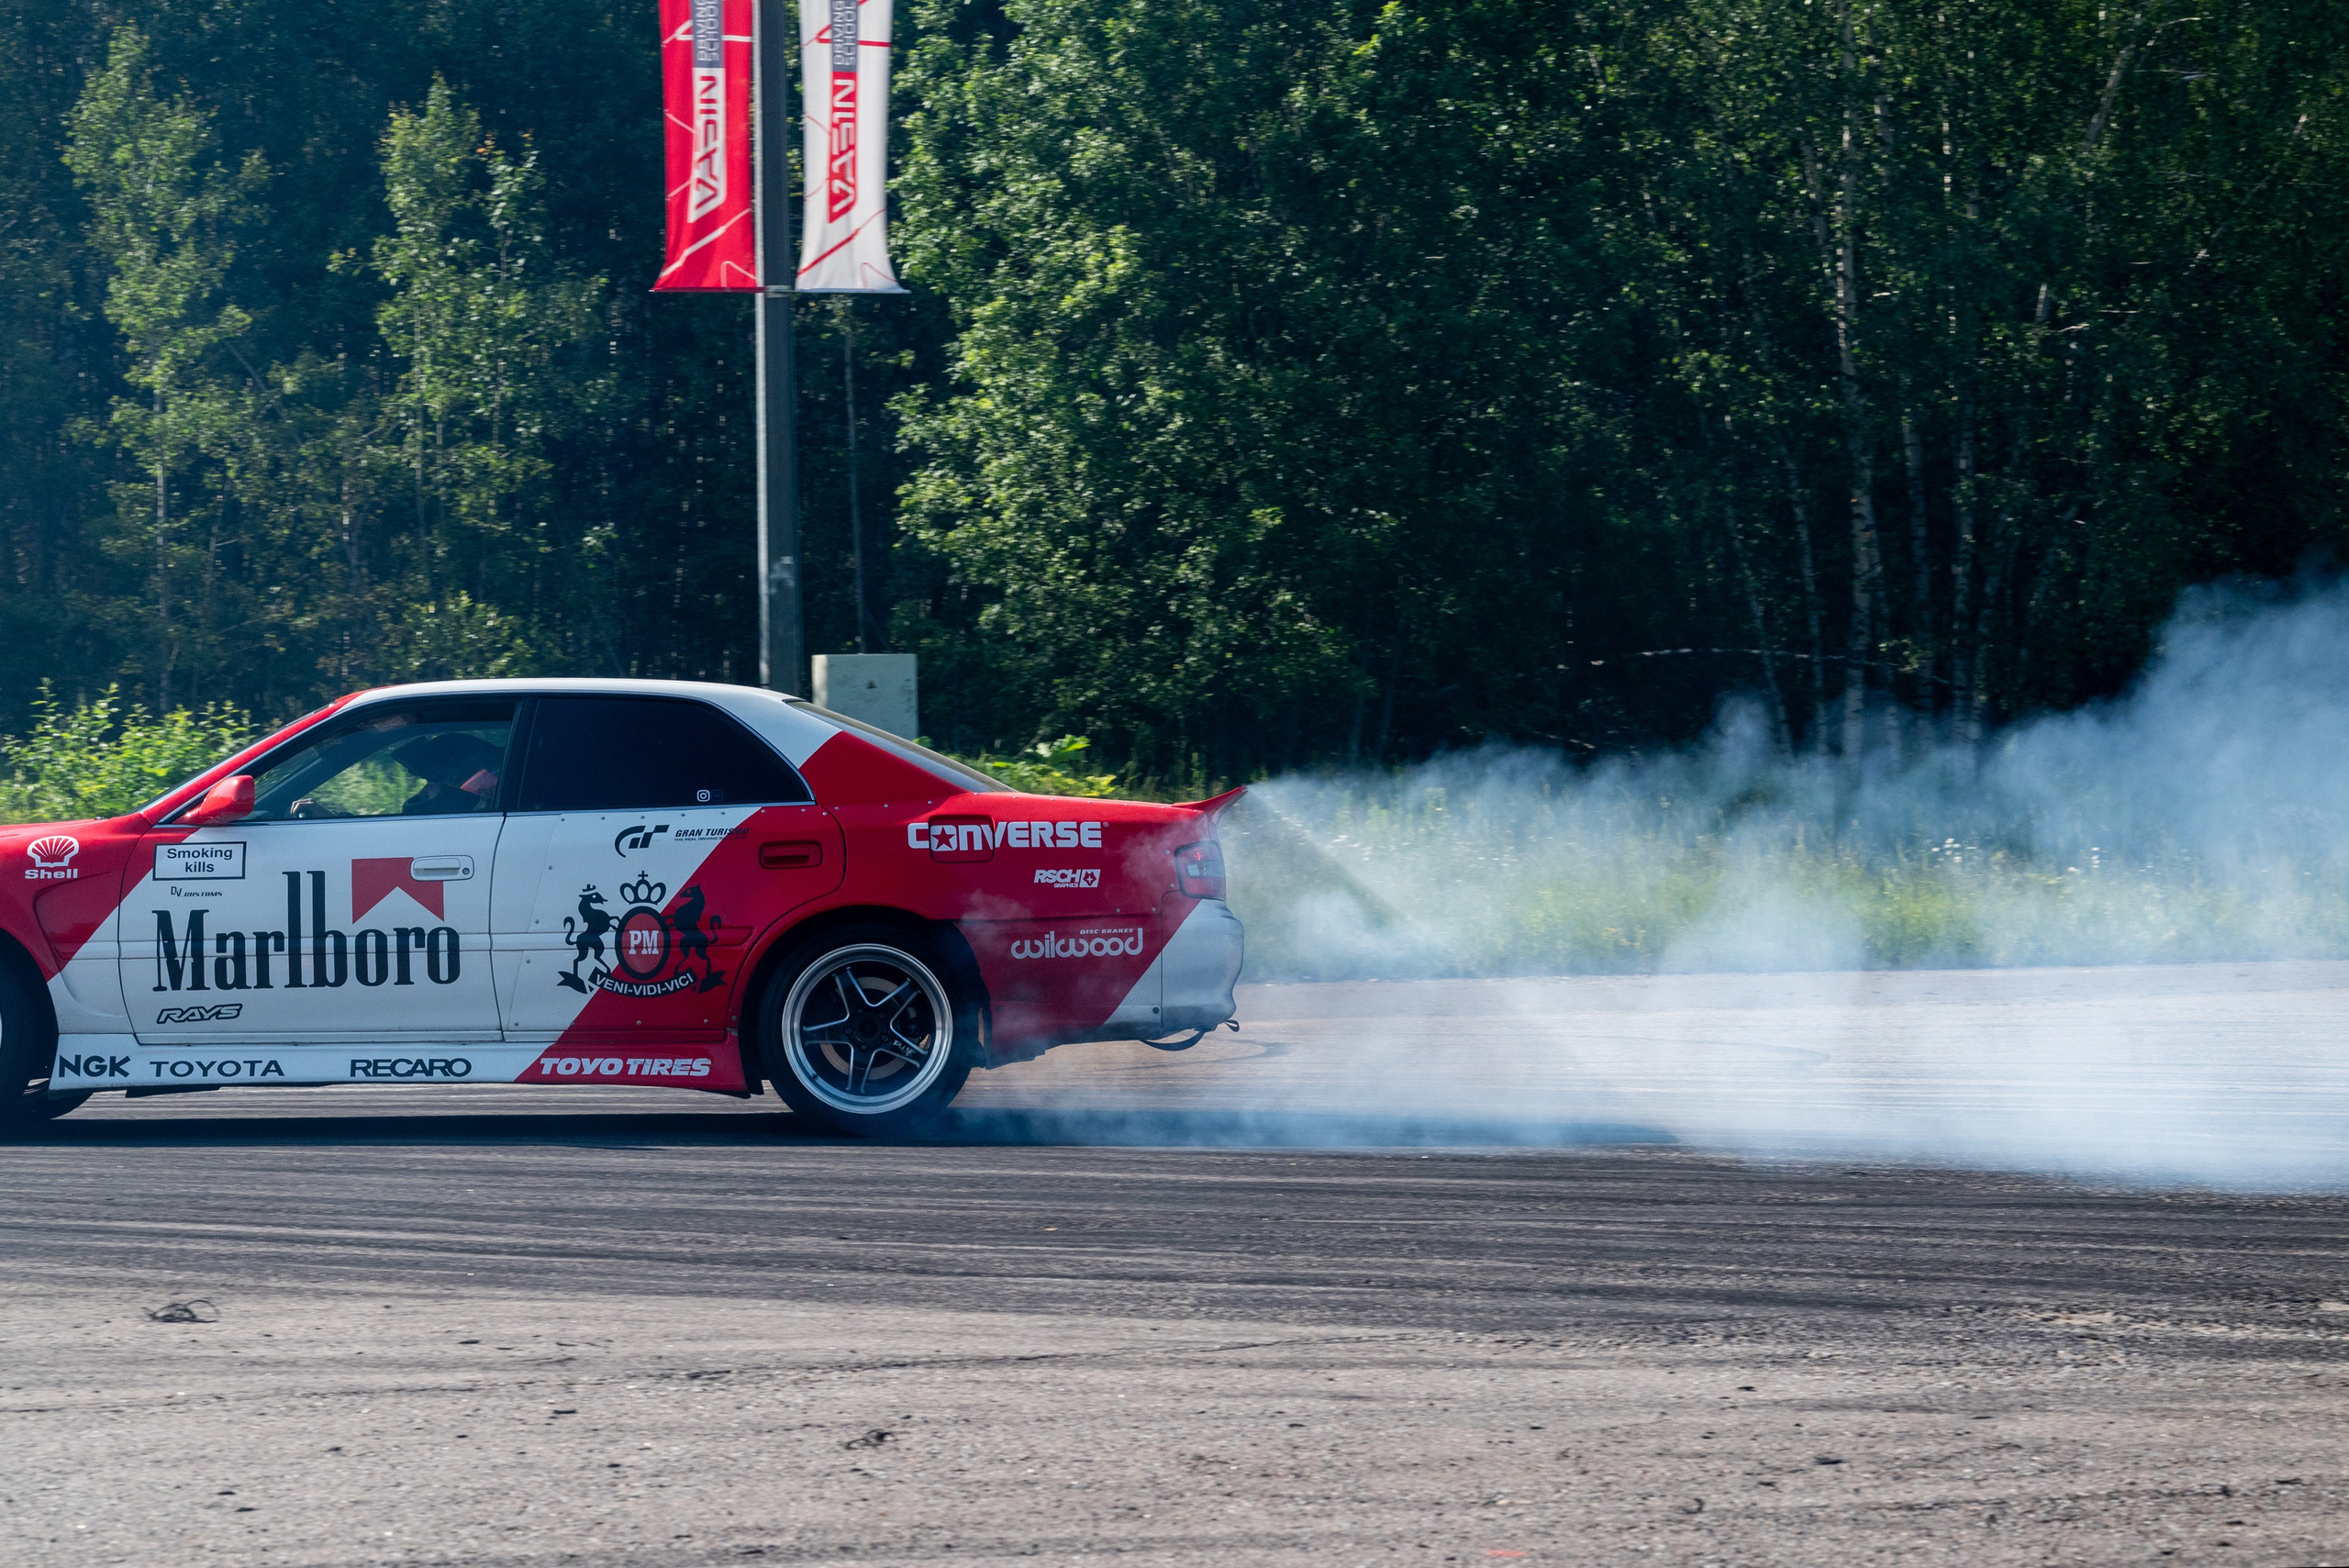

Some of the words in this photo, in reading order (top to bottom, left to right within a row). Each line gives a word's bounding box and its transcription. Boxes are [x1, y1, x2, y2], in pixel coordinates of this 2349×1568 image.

[832, 0, 844, 64] DRIVING
[842, 1, 856, 65] SCHOOL
[675, 828, 703, 837] GRAN
[706, 828, 750, 836] TURISMO
[167, 847, 233, 861] Smoking
[25, 869, 78, 879] Shell
[184, 862, 215, 873] kills
[1033, 869, 1081, 883] RSCH
[152, 871, 461, 992] Marlboro
[629, 929, 659, 955] PM
[1010, 927, 1143, 960] wilwood
[596, 973, 694, 996] VENI-VIDI-VICI
[156, 1003, 243, 1025] RAYS
[59, 1054, 131, 1078] NGK
[150, 1060, 284, 1077] TOYOTA
[351, 1057, 472, 1077] RECARO
[540, 1057, 624, 1075] TOYO
[626, 1057, 711, 1076] TIRES
